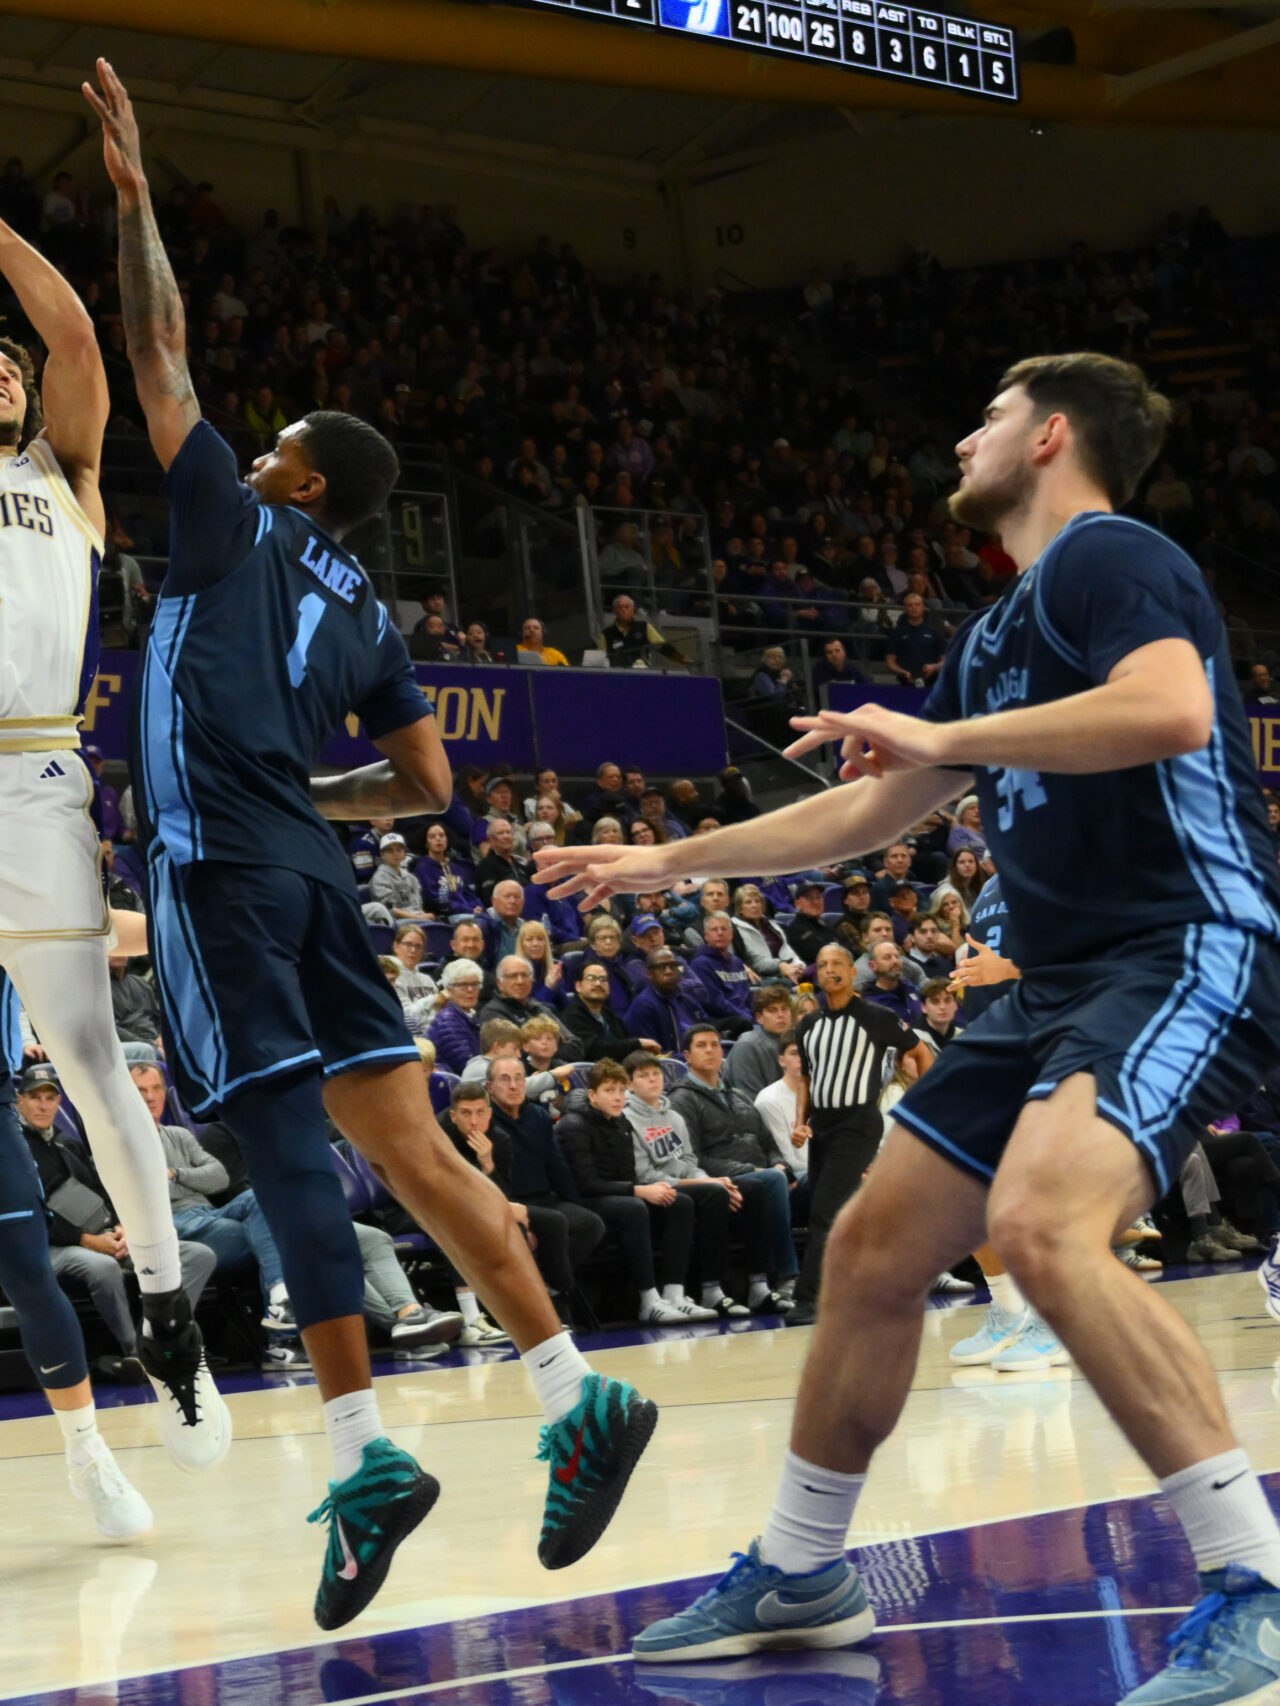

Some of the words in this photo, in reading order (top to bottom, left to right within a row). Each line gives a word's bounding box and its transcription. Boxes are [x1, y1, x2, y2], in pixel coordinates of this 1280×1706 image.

[737, 5, 761, 33] 21
[767, 12, 803, 42] 100
[810, 21, 836, 48] 25
[852, 30, 866, 55] 8
[889, 38, 904, 63] 3
[923, 46, 937, 70] 6
[958, 53, 970, 78] 1
[991, 61, 1006, 85] 5
[841, 0, 872, 16] REB
[877, 8, 907, 24] AST
[917, 16, 938, 31] TO
[947, 22, 977, 40] BLK
[982, 30, 1009, 47] STL
[716, 223, 744, 248] 10
[401, 502, 425, 566] 9
[298, 535, 363, 605] LANE
[286, 591, 327, 689] 1
[80, 673, 121, 732] F
